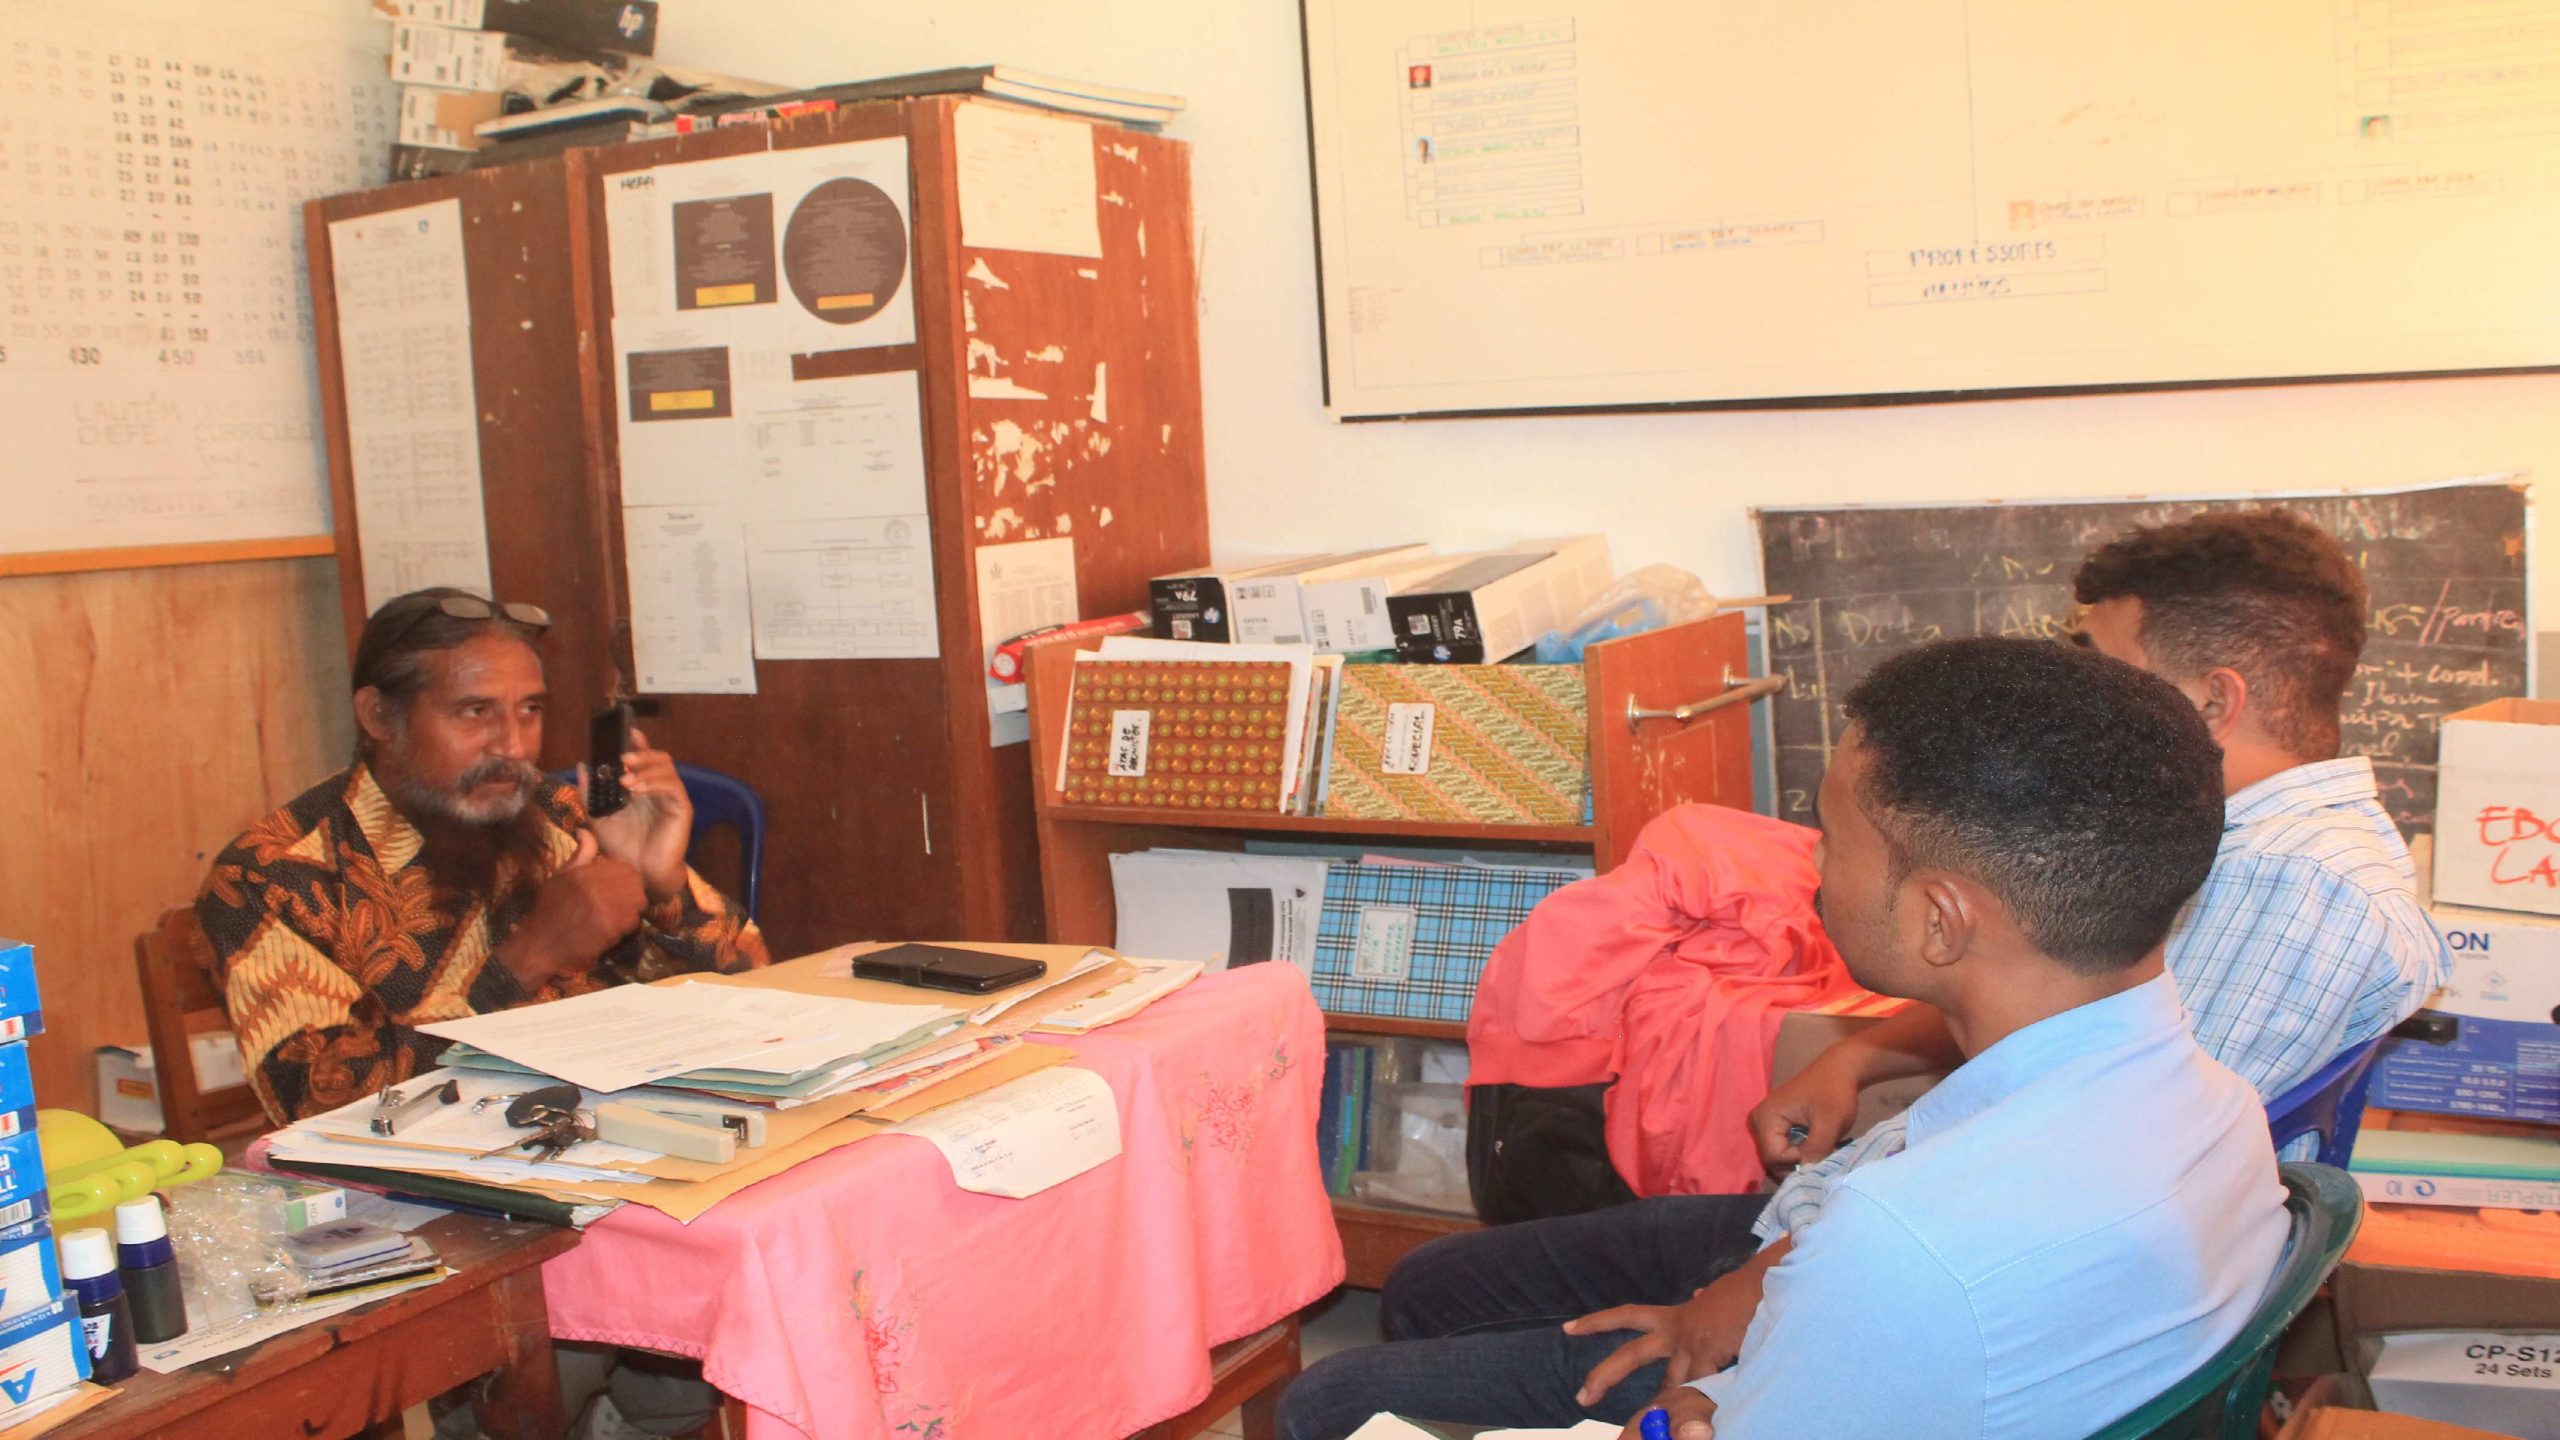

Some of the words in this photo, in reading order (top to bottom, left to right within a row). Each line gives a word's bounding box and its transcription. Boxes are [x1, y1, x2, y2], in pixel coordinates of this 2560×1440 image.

[1452, 617, 1468, 641] 79A
[2445, 930, 2490, 952] ON
[2473, 1362, 2499, 1375] 24
[2505, 1363, 2553, 1379] Sets
